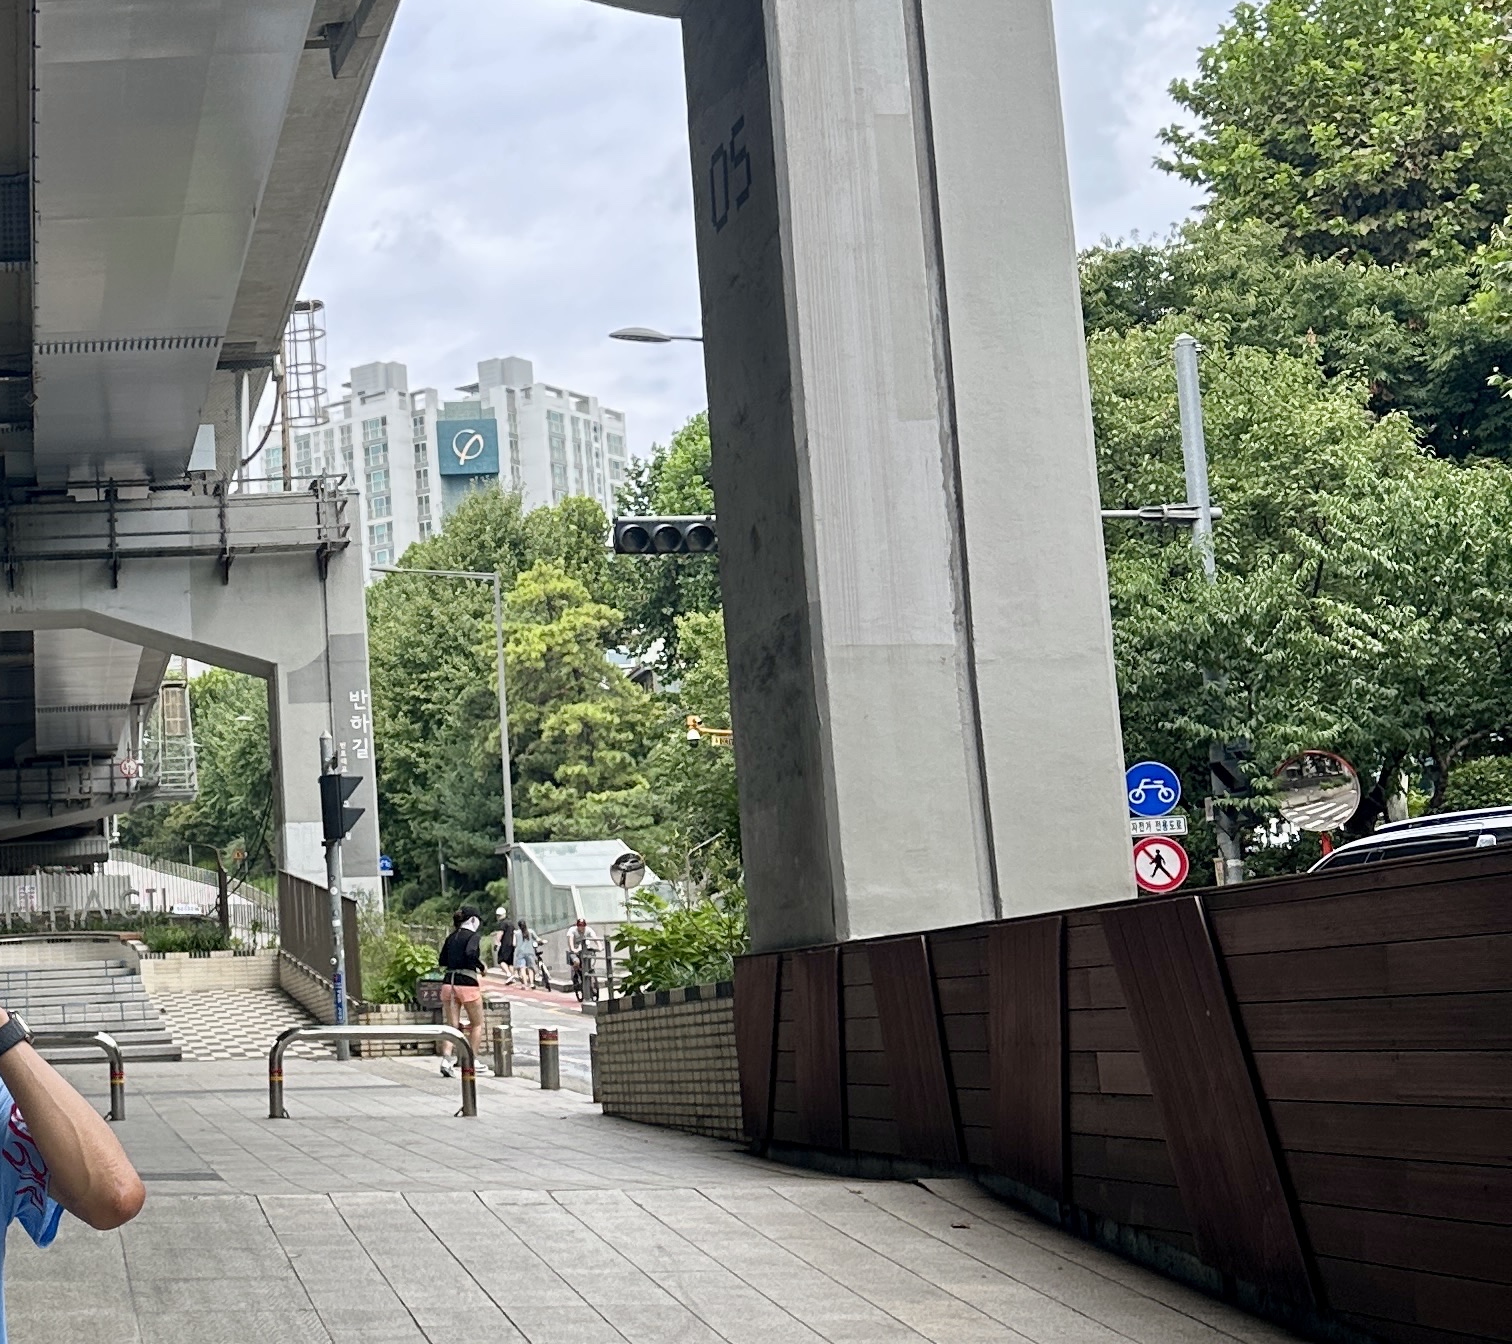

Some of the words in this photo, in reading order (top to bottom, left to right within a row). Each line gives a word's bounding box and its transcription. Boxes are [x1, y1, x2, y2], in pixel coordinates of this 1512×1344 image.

[710, 115, 752, 235] 05
[349, 689, 371, 759] 반하길
[1131, 821, 1152, 833] 자전거
[1155, 819, 1182, 832] 전용도로
